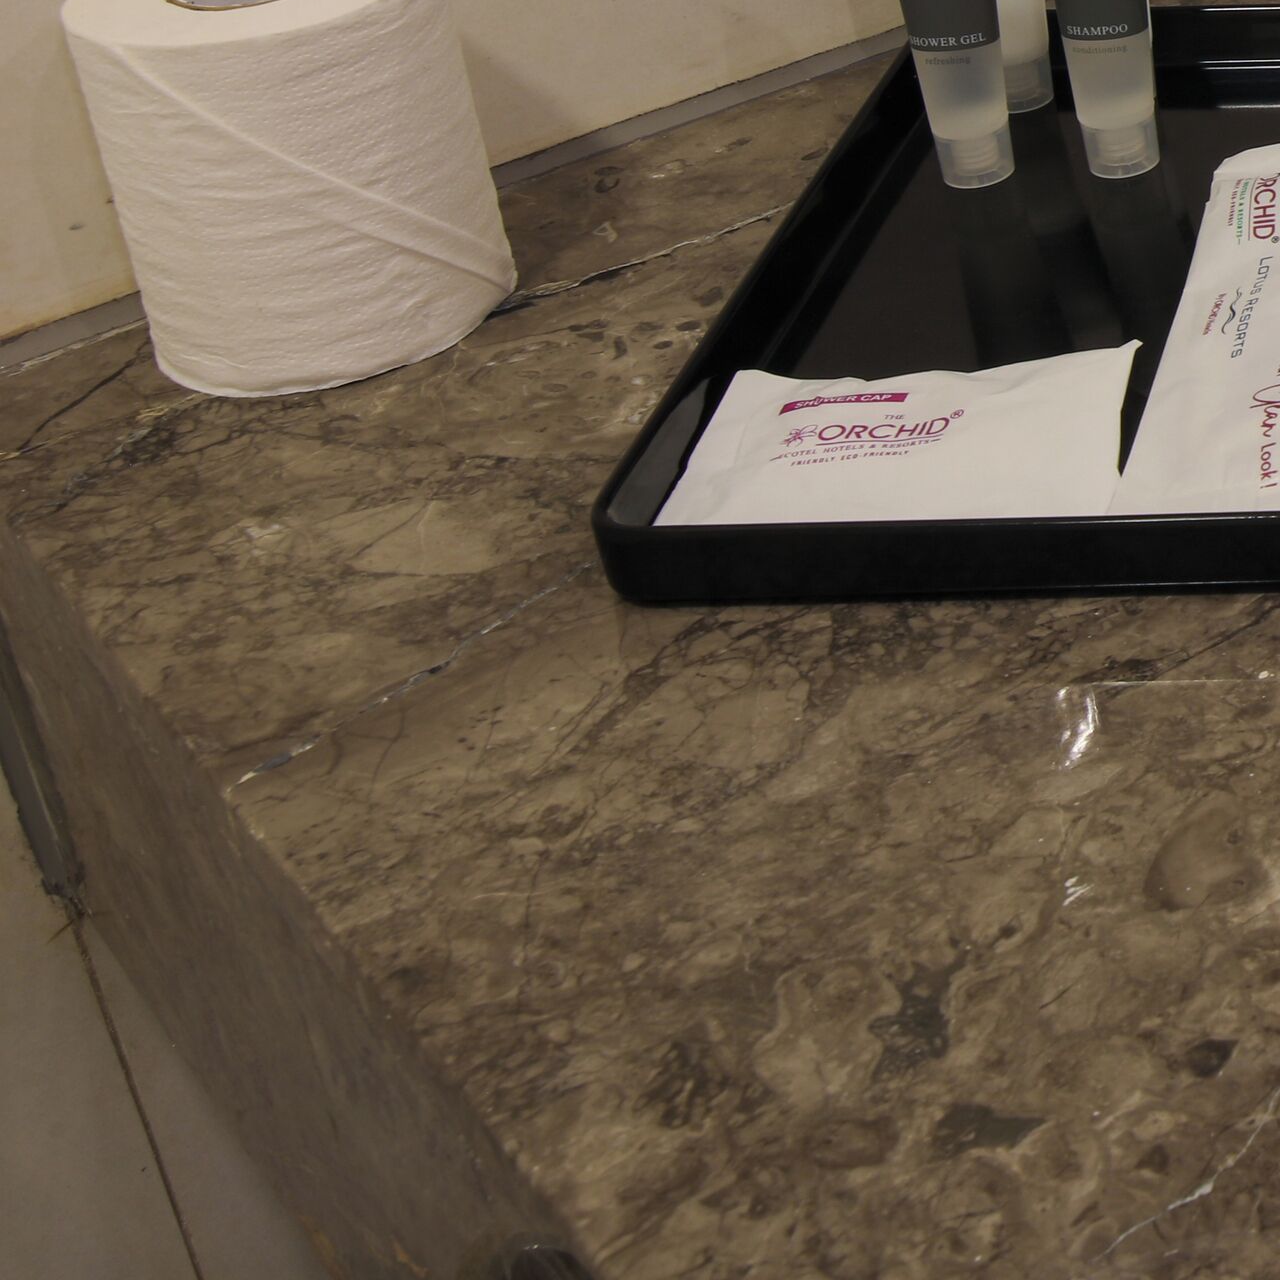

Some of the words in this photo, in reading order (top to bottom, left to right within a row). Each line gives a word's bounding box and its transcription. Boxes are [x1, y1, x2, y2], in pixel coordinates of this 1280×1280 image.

[1066, 23, 1128, 36] SHAMPOO
[909, 35, 958, 47] SHOWER
[960, 32, 986, 45] GEL
[1250, 256, 1273, 295] LOTUS
[1231, 297, 1259, 359] RESORTS
[860, 393, 892, 402] CAP
[823, 444, 865, 453] HOTELS
[881, 438, 931, 449] RESORTS
[790, 456, 835, 467] FRIENDLY
[840, 450, 909, 461] ECO-FRIENDLY
